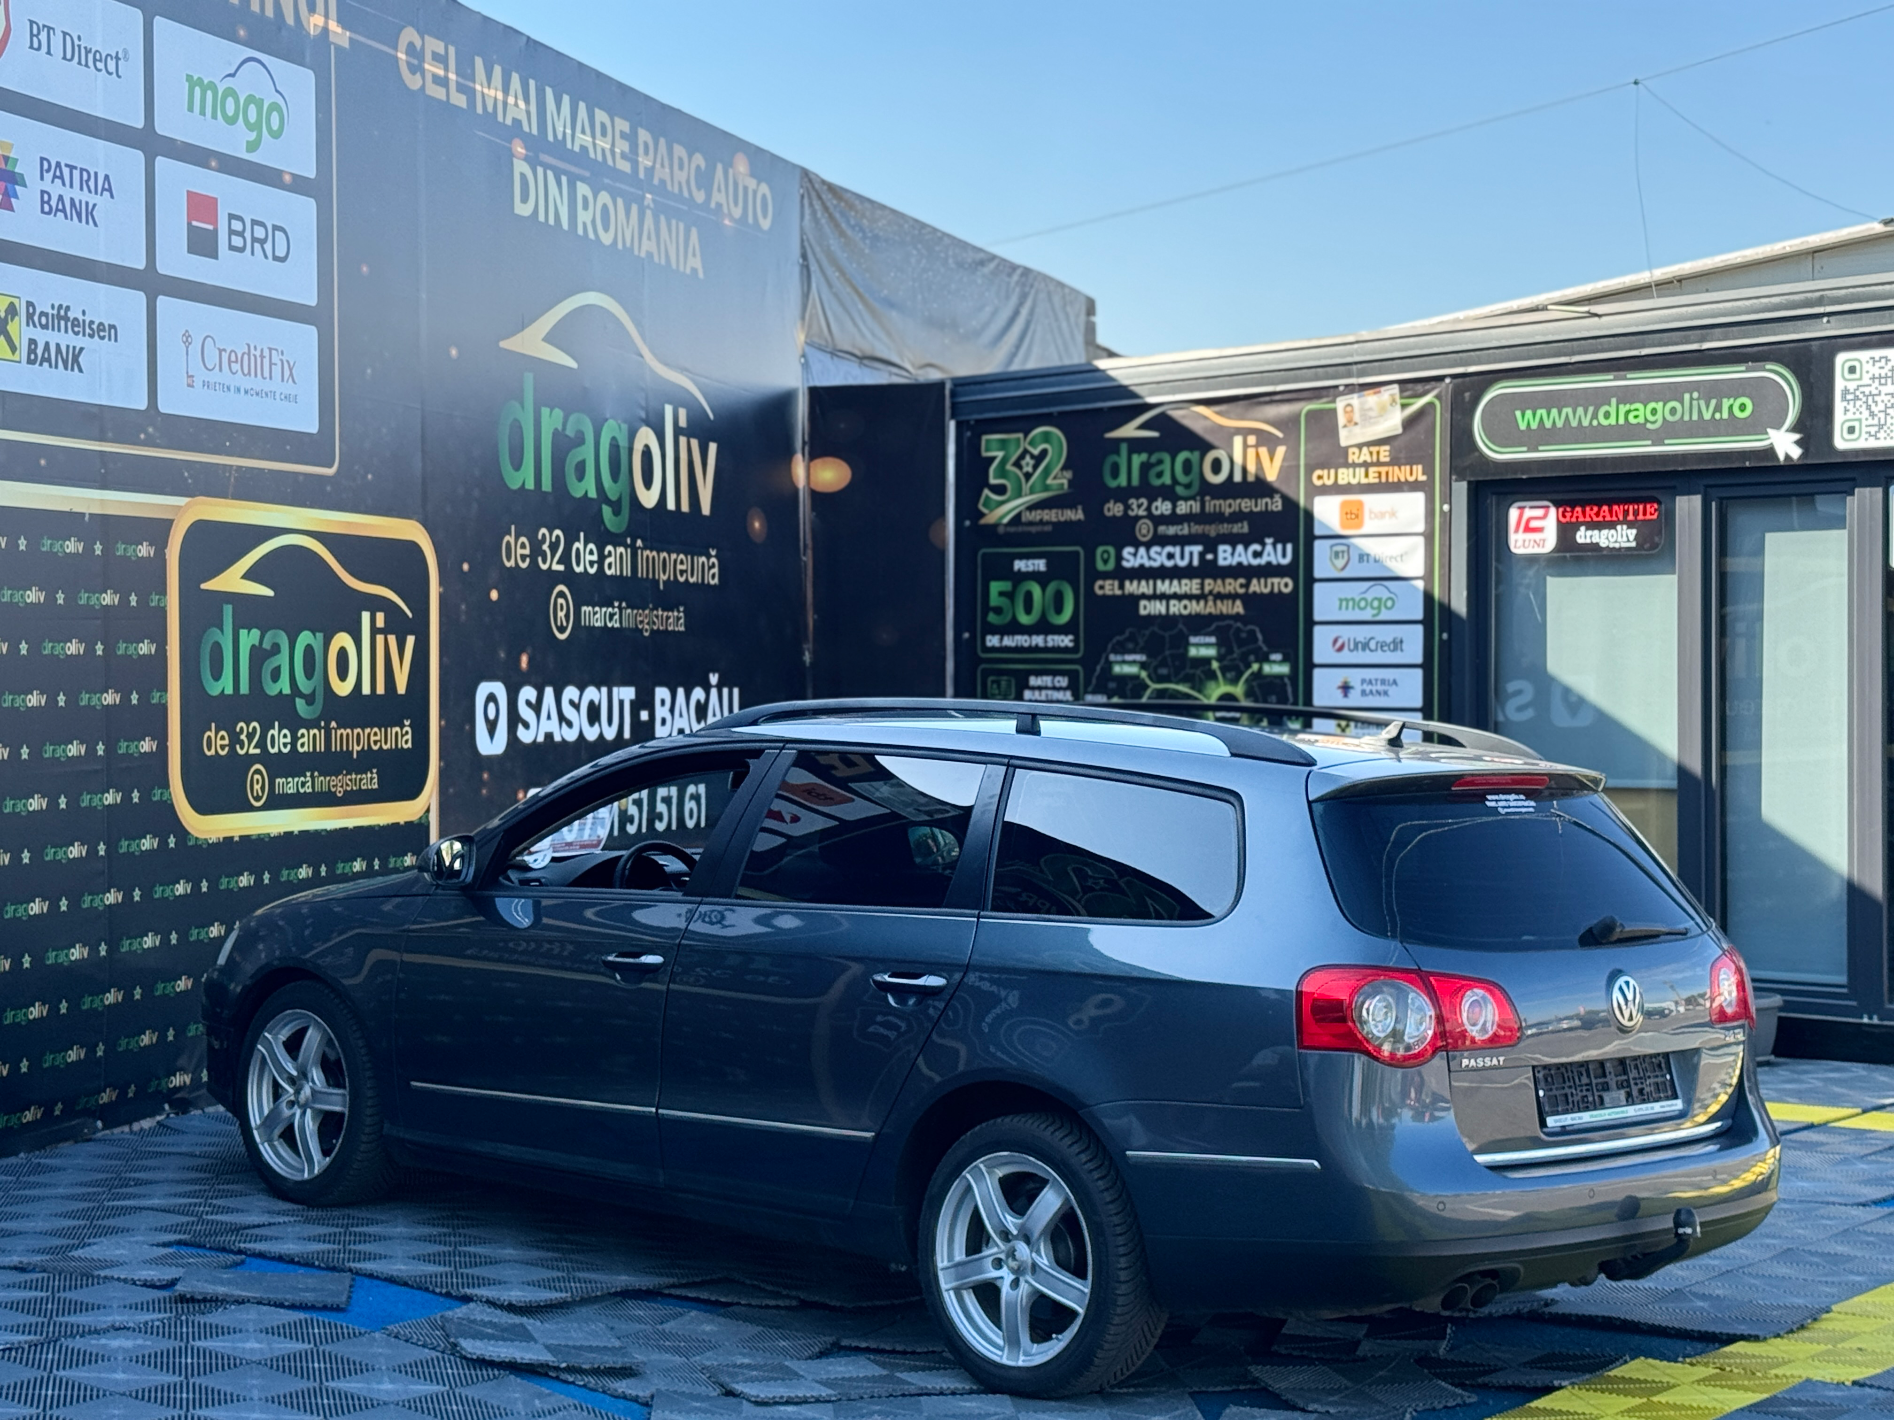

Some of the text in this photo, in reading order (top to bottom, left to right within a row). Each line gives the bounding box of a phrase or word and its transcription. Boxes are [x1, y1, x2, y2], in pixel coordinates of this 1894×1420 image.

[28, 19, 57, 53] BT
[185, 73, 286, 154] mogo
[397, 26, 773, 231] CEL MAI MARE PARC AUTO
[39, 156, 115, 200] PATRIA
[39, 189, 99, 228] BANK
[512, 158, 704, 279] DIN ROMÂNIA
[227, 212, 291, 264] BRD
[25, 300, 118, 344] Raiffeisen
[26, 337, 85, 374] BANK
[200, 334, 298, 386] CreditFix
[202, 379, 298, 405] PRIETEN IN MOMENTE CHEIE
[1514, 391, 1754, 431] www.dragoliv.ro
[500, 373, 718, 534] dragoliv
[1102, 434, 1288, 497] dragoliv
[1348, 445, 1391, 464] RATE
[977, 425, 1069, 516] 32
[1312, 464, 1428, 486] CU BULETINUL
[1104, 494, 1283, 518] de 32 de ani împreună
[1344, 507, 1399, 520] tbi bank
[1513, 502, 1660, 534] 12 GARANTIE
[1157, 522, 1189, 536] marcă
[1189, 520, 1249, 537] înregistrată
[1575, 525, 1638, 548] dragoliv
[40, 536, 155, 560] dragoliv dragoliv
[502, 525, 720, 590] de 32 de ani împreună
[1121, 545, 1203, 568] SASCUT
[1217, 538, 1293, 567] BACĂU
[1513, 538, 1547, 549] LUNI
[1013, 559, 1047, 572] PESTE
[1358, 553, 1372, 564] BT
[0, 586, 120, 609] dragoliv dragoliv
[1094, 577, 1294, 596] CEL MAI MARE PARC AUTO
[986, 579, 1075, 626] 500
[1139, 596, 1245, 616] DIN ROMÂNIA
[1337, 596, 1396, 618] mogo
[581, 600, 620, 629] marcă
[621, 600, 686, 636] înregistrată
[41, 638, 156, 659] dragoliv dragoliv
[985, 635, 1075, 647] DE AUTO PE STOC
[1347, 636, 1404, 653] UniCredit
[200, 604, 415, 719] dragoliv
[1360, 678, 1399, 688] PATRIA
[1360, 689, 1390, 698] BANK
[2, 689, 121, 711] dragoliv dragoliv
[516, 685, 636, 744] SASCUT
[42, 737, 157, 761] dragoliv dragoliv
[203, 719, 413, 759] de 32 de ani împreună
[275, 770, 312, 795] marcă
[314, 768, 379, 797] înregistrată
[3, 794, 48, 815] dragoliv
[79, 788, 122, 809] dragoliv
[654, 785, 678, 833] 51
[684, 783, 706, 830] 61
[43, 841, 87, 863] dragoliv
[118, 834, 159, 855] dragoliv
[3, 852, 417, 920] dragoliv dragoliv dragoliv dragoliv dragoliv dragoliv dragoliv
[45, 922, 226, 966] dragoliv dragoliv dragoliv
[3, 975, 193, 1025] dragoliv dragoliv dragoliv
[42, 1044, 87, 1068] dragoliv
[116, 1029, 159, 1052] dragoliv
[1461, 1056, 1505, 1070] PASSAT
[147, 1071, 192, 1093] dragoliv
